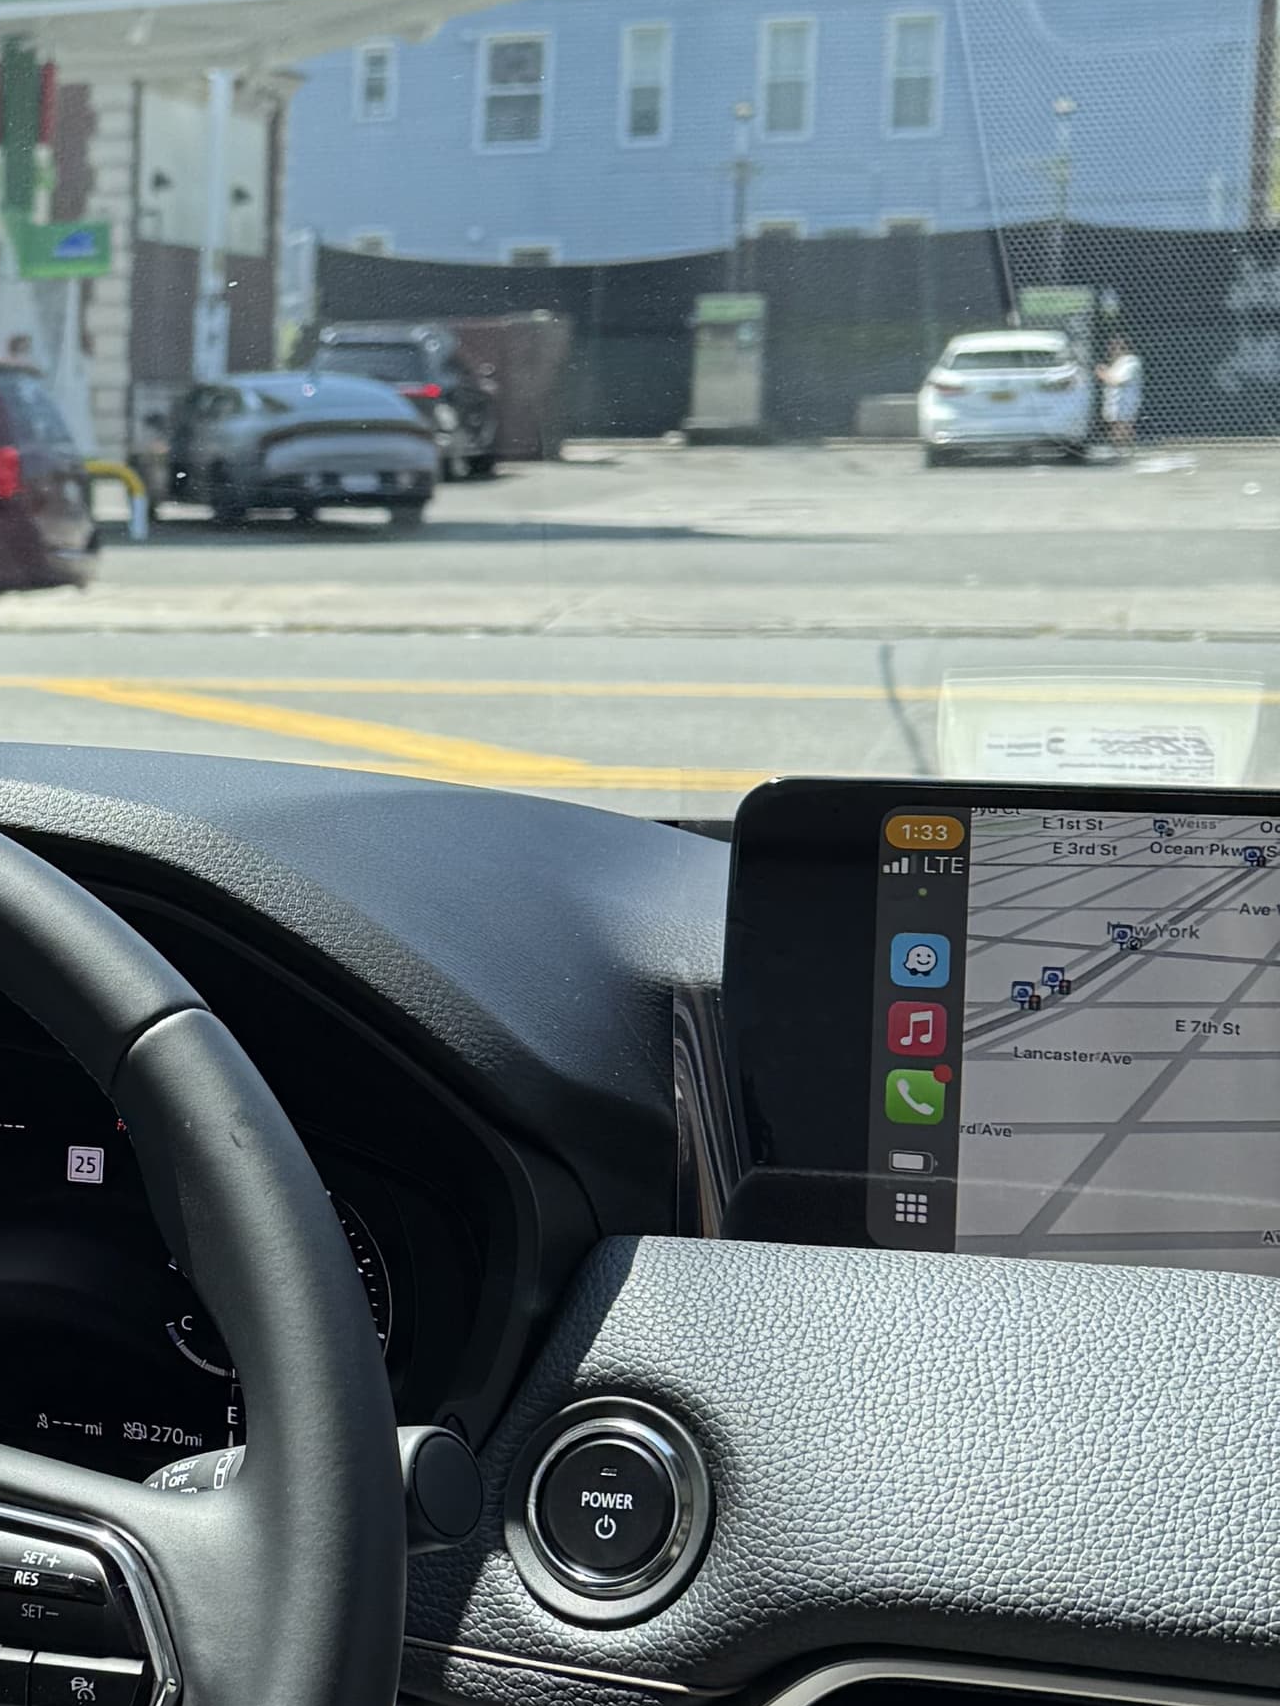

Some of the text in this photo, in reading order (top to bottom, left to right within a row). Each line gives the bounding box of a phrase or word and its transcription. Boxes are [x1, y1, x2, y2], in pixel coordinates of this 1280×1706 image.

[1043, 817, 1104, 831] E 1st St
[1172, 818, 1217, 830] Weiss
[902, 824, 947, 841] 1:33
[1053, 842, 1118, 856] E 3rd St
[1150, 841, 1204, 855] Ocean
[924, 856, 964, 874] LTE
[1240, 903, 1271, 916] Ave
[1154, 923, 1200, 940] York
[1175, 1020, 1241, 1036] E 7th St
[1013, 1046, 1132, 1065] Lancaster Ave
[981, 1124, 1012, 1138] Ave
[74, 1156, 96, 1174] 25
[181, 1315, 193, 1331] C
[227, 1406, 239, 1424] E
[168, 1473, 190, 1488] OFF
[581, 1491, 633, 1510] POWER
[14, 1570, 40, 1587] RES
